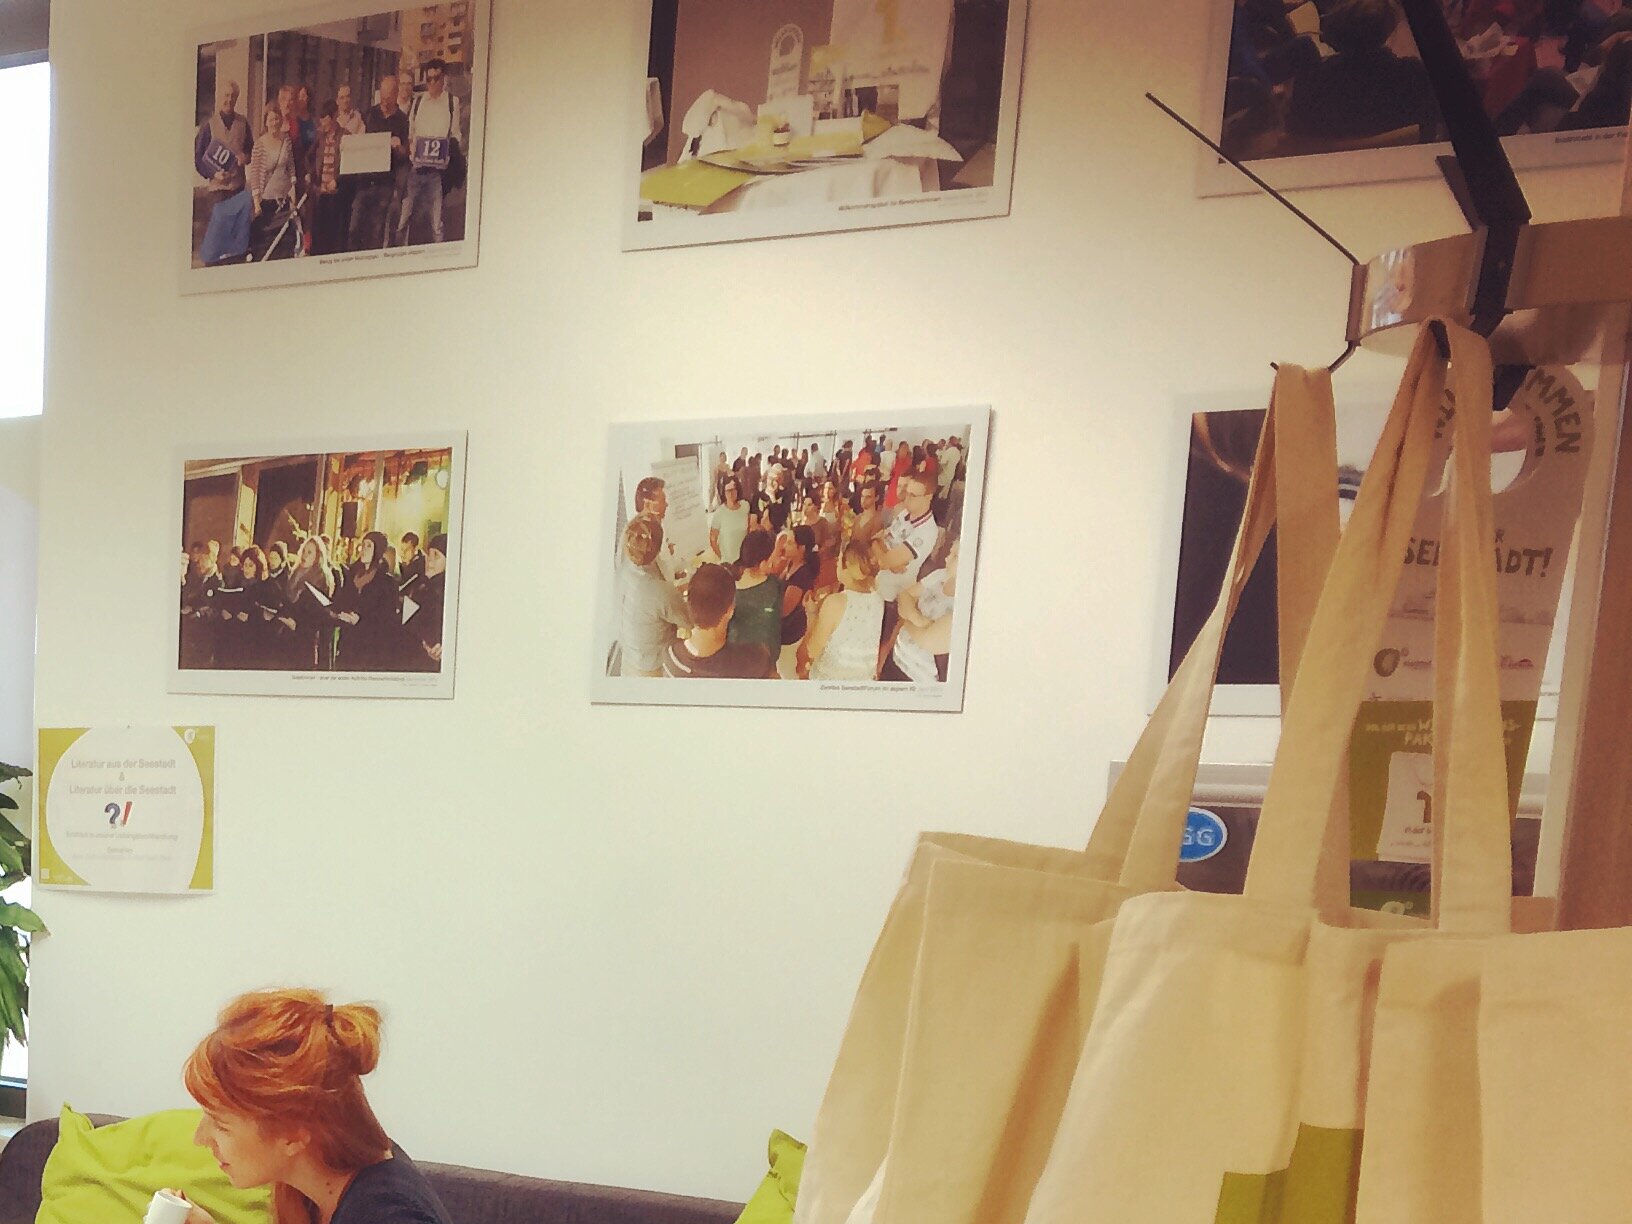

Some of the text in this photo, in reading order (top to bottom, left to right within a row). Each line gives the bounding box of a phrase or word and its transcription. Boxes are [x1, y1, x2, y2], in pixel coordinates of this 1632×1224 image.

[423, 140, 441, 156] 12
[212, 145, 230, 165] 10
[71, 759, 176, 769] Literatur aus der Seestadt
[69, 784, 176, 795] Literatur über die Seestadt
